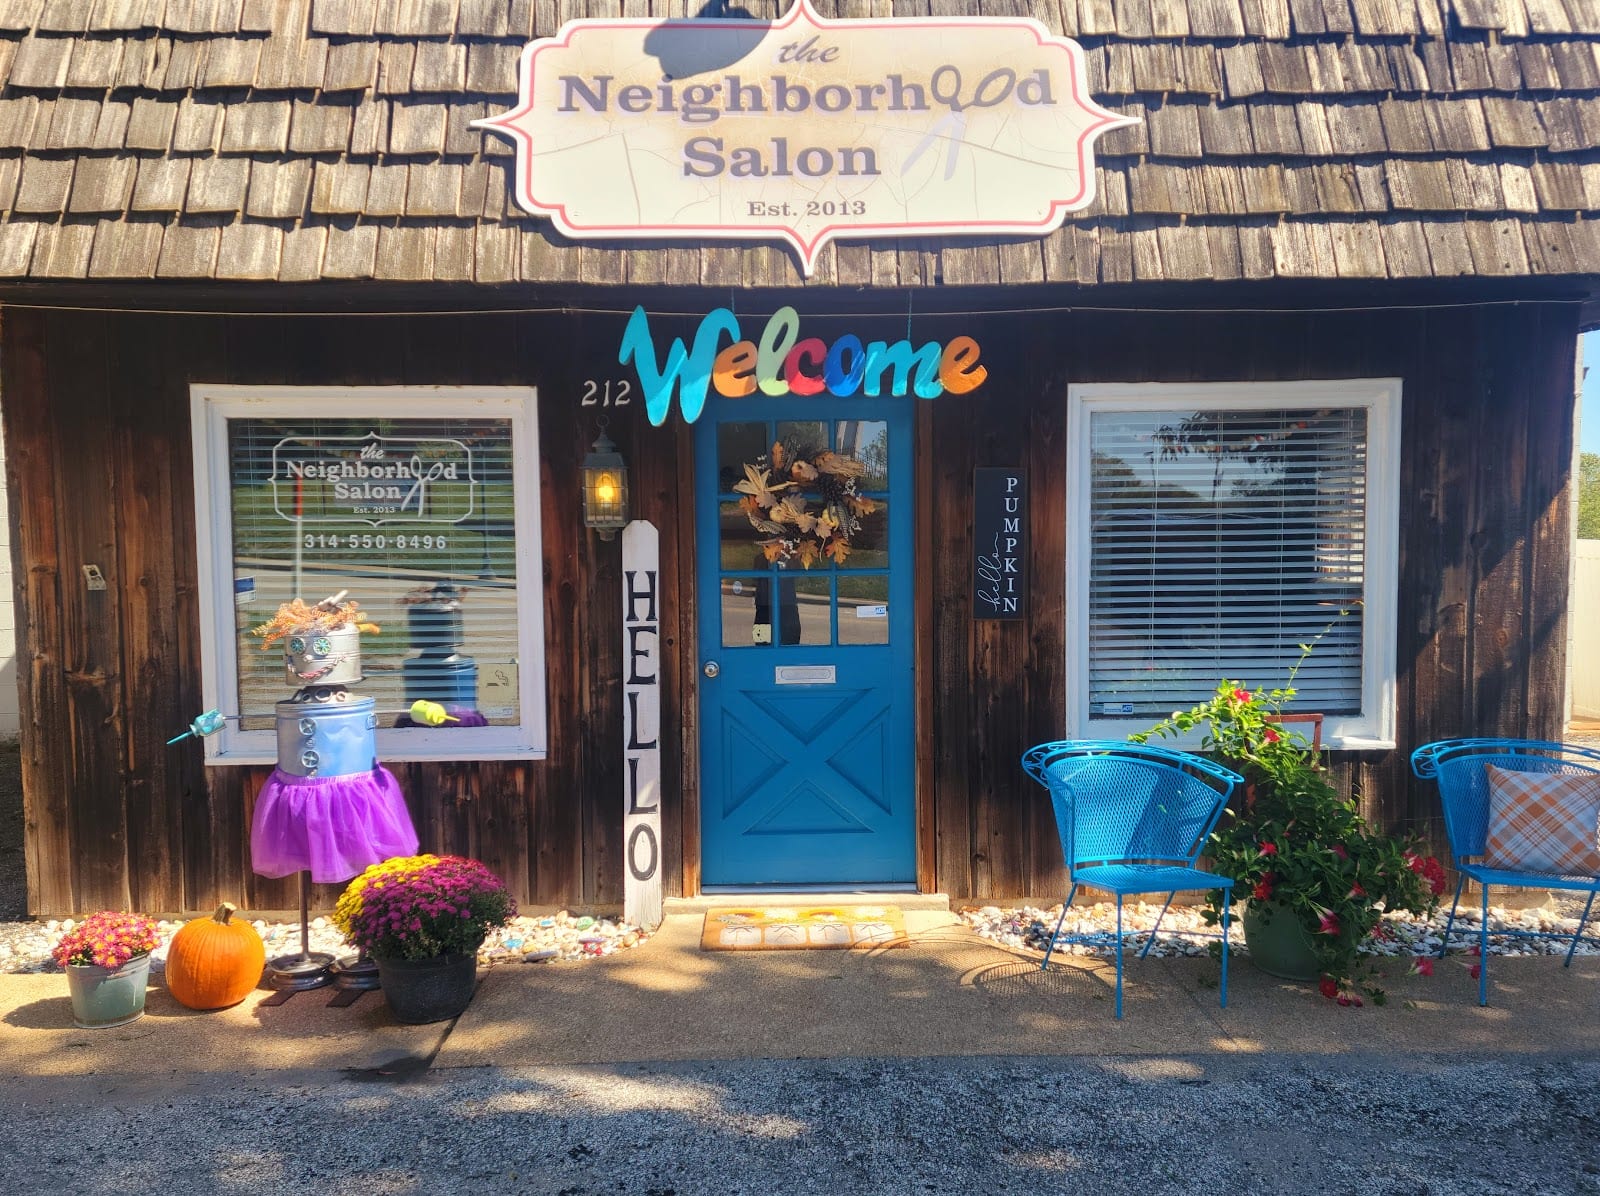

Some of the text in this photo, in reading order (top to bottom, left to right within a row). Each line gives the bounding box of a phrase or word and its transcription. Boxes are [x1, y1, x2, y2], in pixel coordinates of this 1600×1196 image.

[777, 35, 840, 63] the
[683, 136, 882, 177] Salon
[747, 200, 866, 216] Est. 2013
[619, 305, 988, 426] Welcome
[581, 380, 631, 407] 212
[360, 442, 385, 460] the
[334, 482, 401, 499] Salon
[353, 506, 396, 514] Est. 2013
[1002, 477, 1020, 612] PUMPKIN
[977, 531, 1002, 612] hello
[624, 570, 659, 882] HELLO
